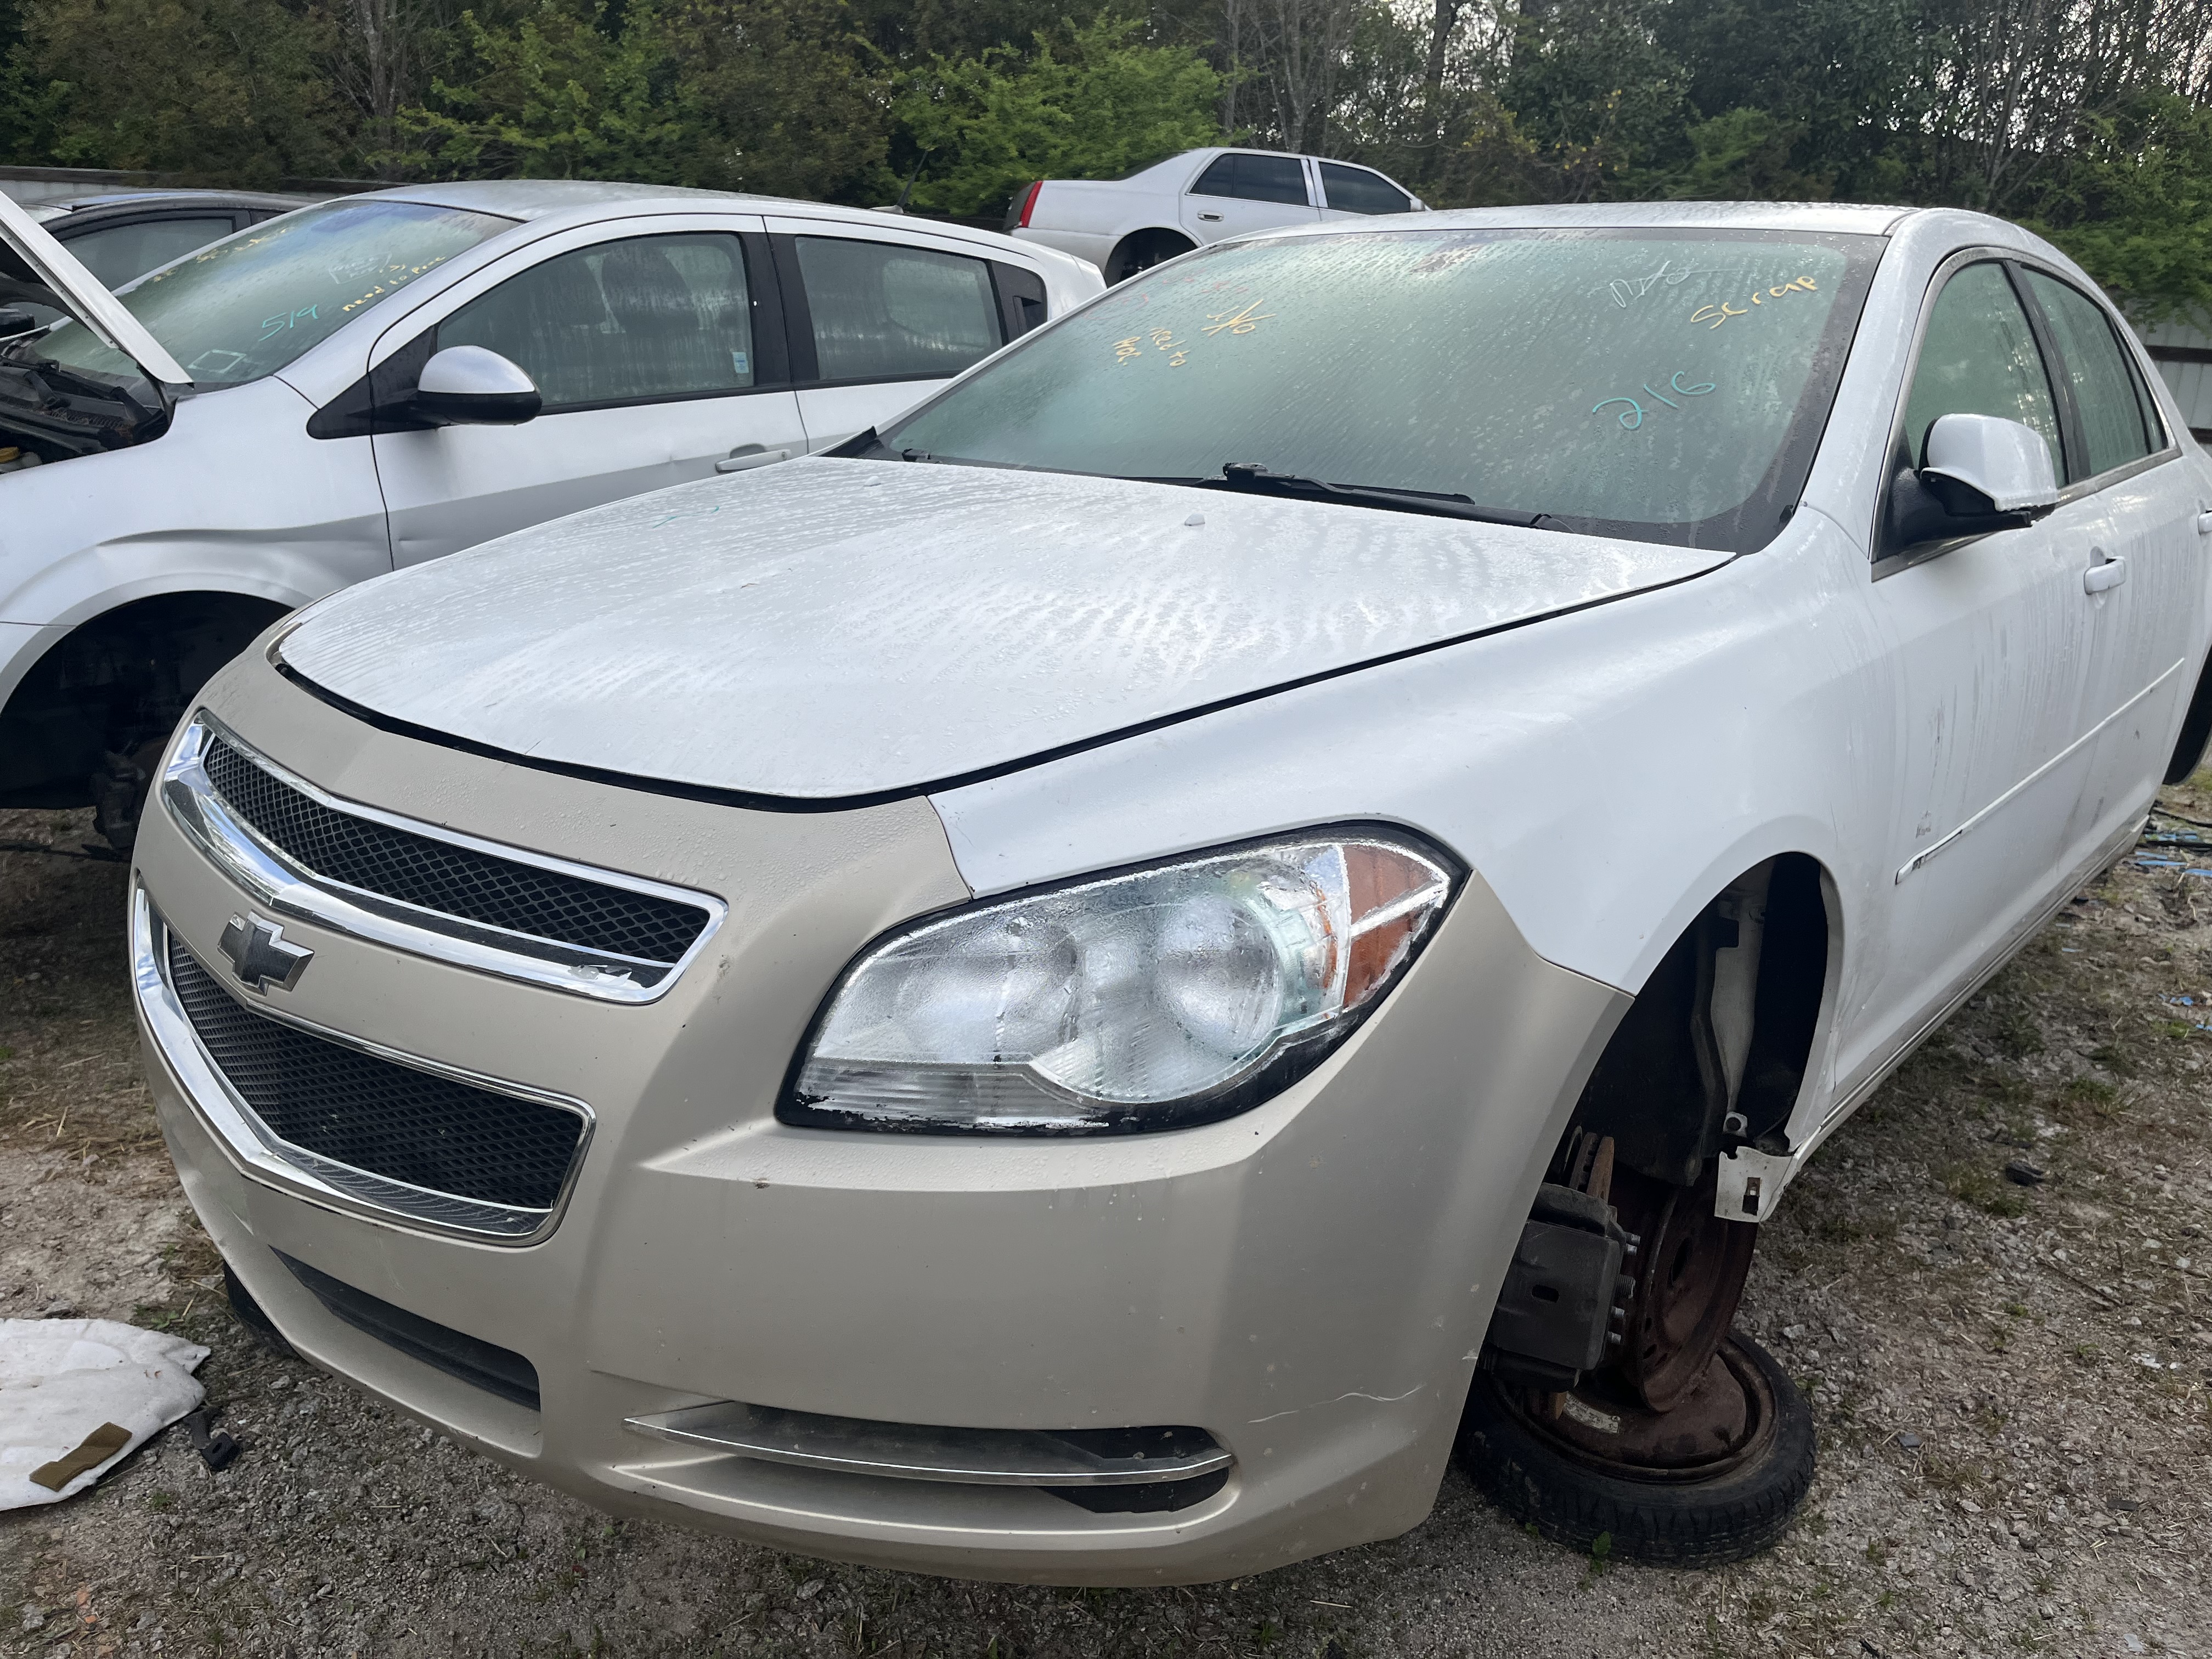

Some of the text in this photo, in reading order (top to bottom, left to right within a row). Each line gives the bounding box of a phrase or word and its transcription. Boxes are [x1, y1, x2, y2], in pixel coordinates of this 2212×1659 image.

[259, 303, 320, 342] 519
[1690, 275, 1818, 329] Scrap
[1592, 371, 1716, 431] 216
